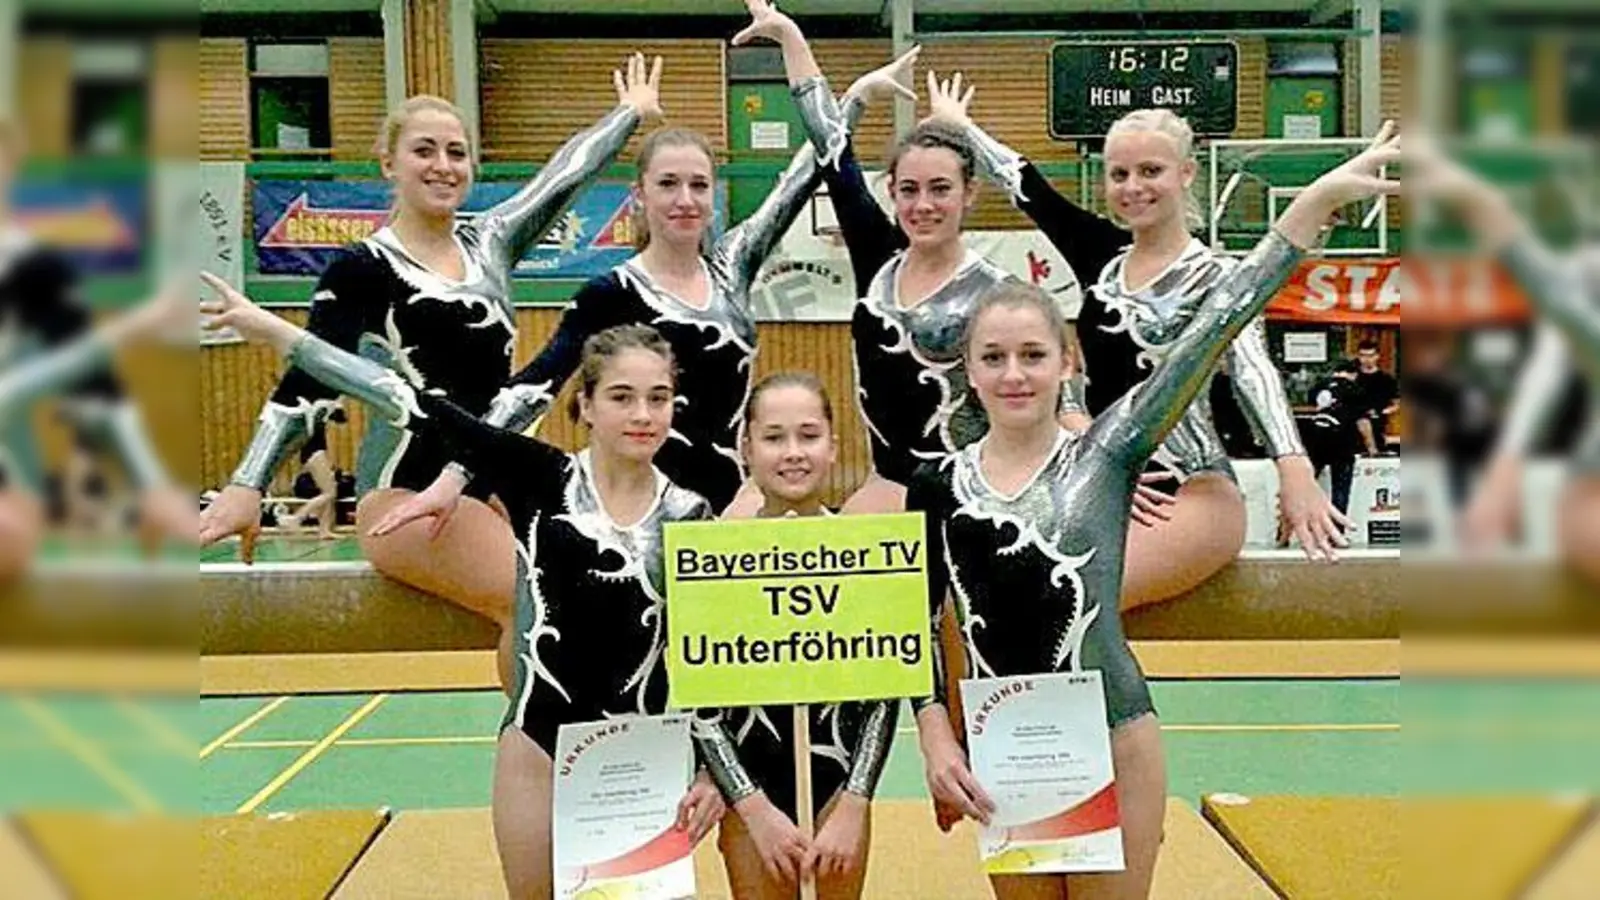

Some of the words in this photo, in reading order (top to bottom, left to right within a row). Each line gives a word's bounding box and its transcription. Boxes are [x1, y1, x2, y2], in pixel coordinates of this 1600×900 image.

[1090, 86, 1132, 106] HEIM
[676, 545, 870, 578] Bayerischer
[879, 540, 920, 566] TV
[763, 584, 840, 616] TSV
[682, 628, 921, 665] Unterföhring
[972, 680, 1035, 736] URKUNDE
[560, 723, 629, 776] URKUNDE
